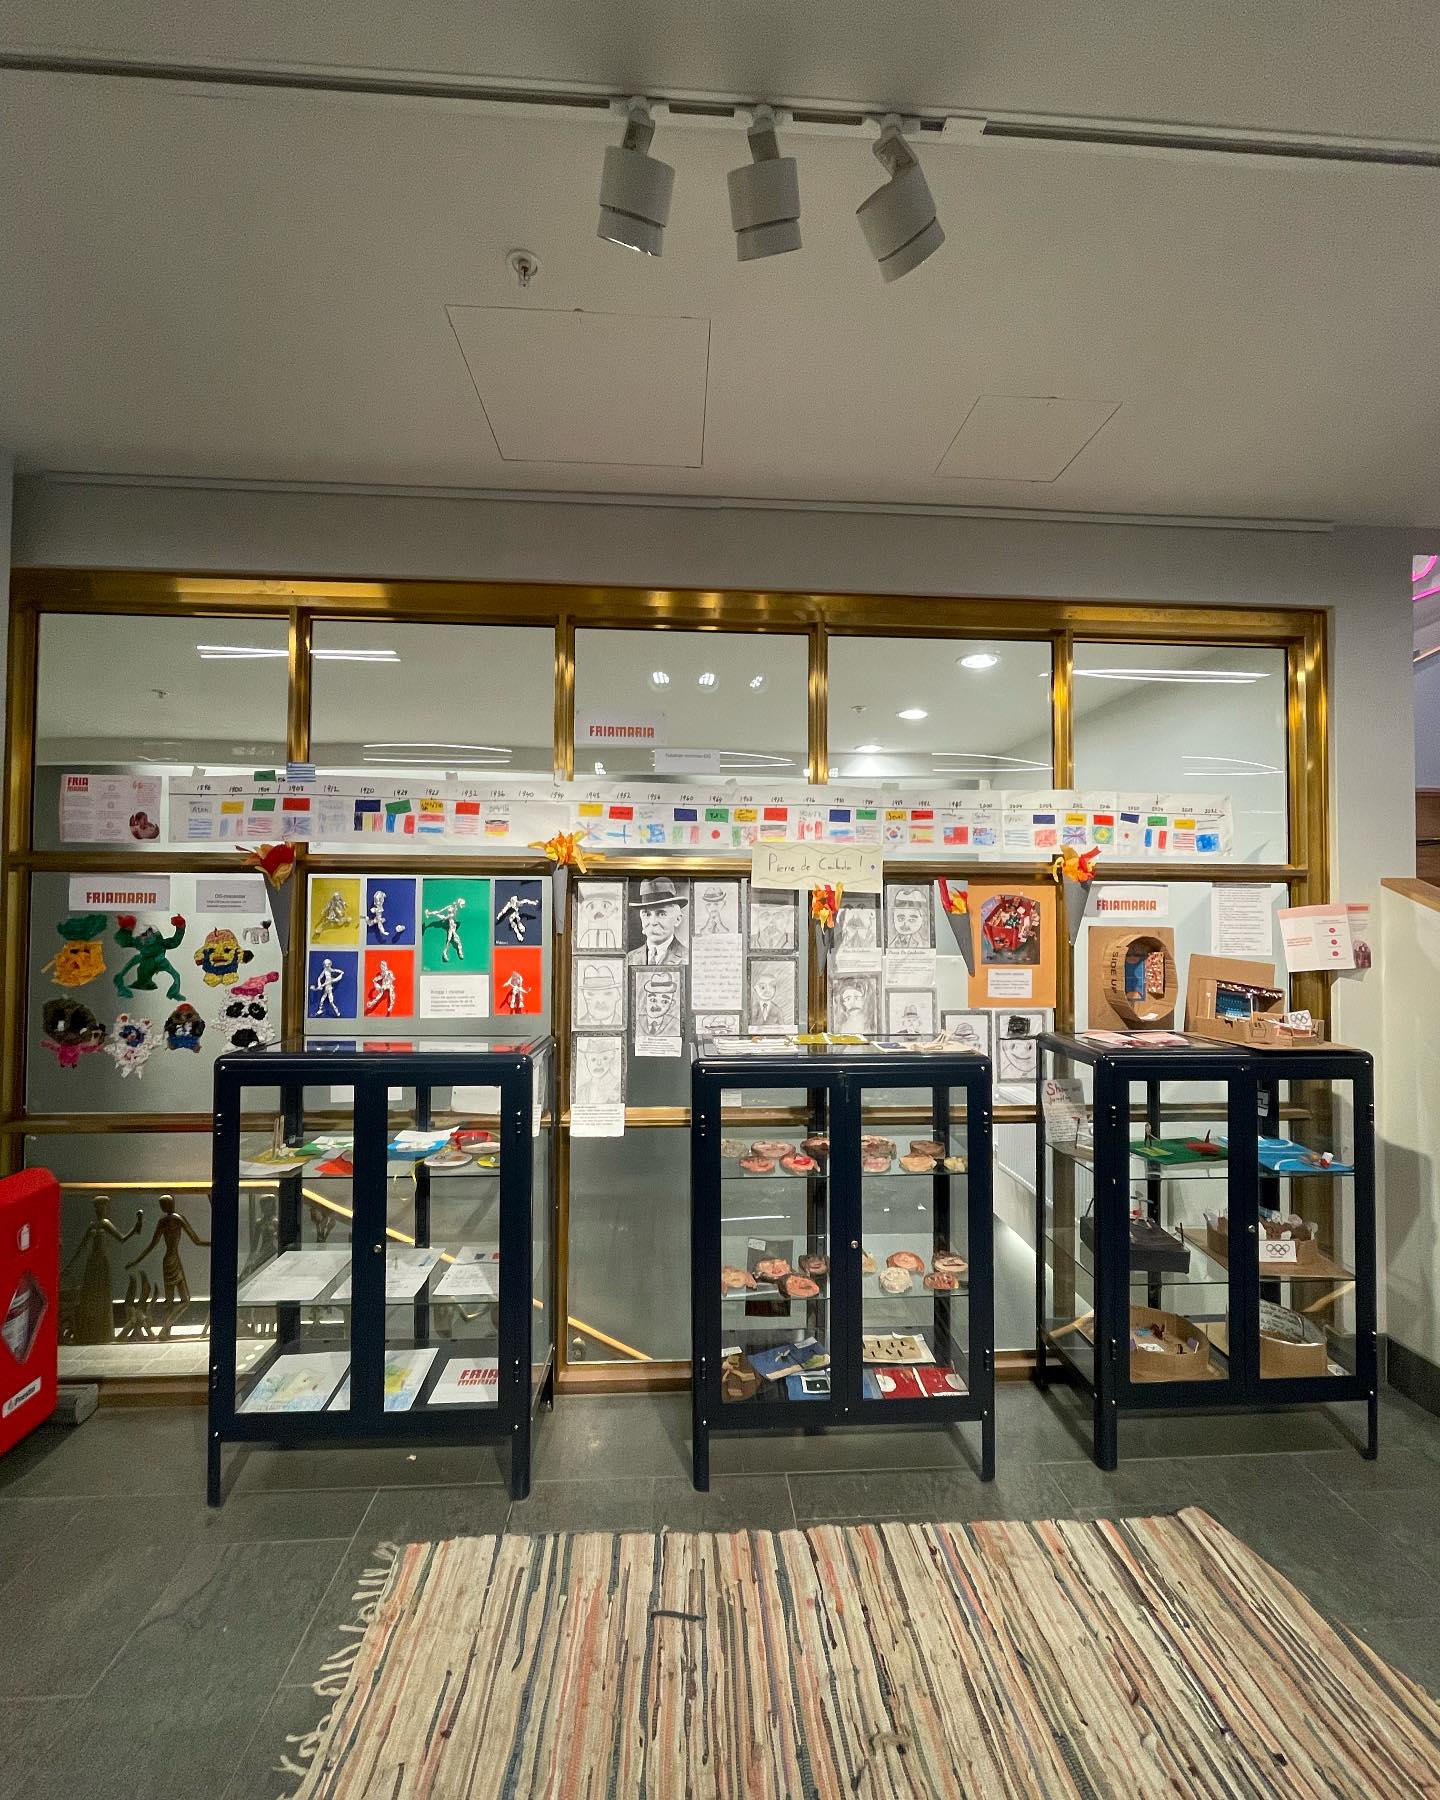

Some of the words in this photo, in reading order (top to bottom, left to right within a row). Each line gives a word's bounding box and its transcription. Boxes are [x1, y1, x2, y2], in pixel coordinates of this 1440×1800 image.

[589, 725, 655, 738] FRIAMARIA
[67, 777, 89, 786] FRIA
[461, 789, 478, 797] 1932
[518, 790, 534, 798] 1940
[586, 791, 600, 799] 1948
[616, 791, 632, 799] 1952
[647, 792, 661, 800] 1956
[86, 891, 157, 904] FRIAMARIA
[1096, 899, 1157, 911] FRIAMARIA
[1110, 951, 1119, 976] SIDE
[460, 1368, 499, 1380] FRIA
